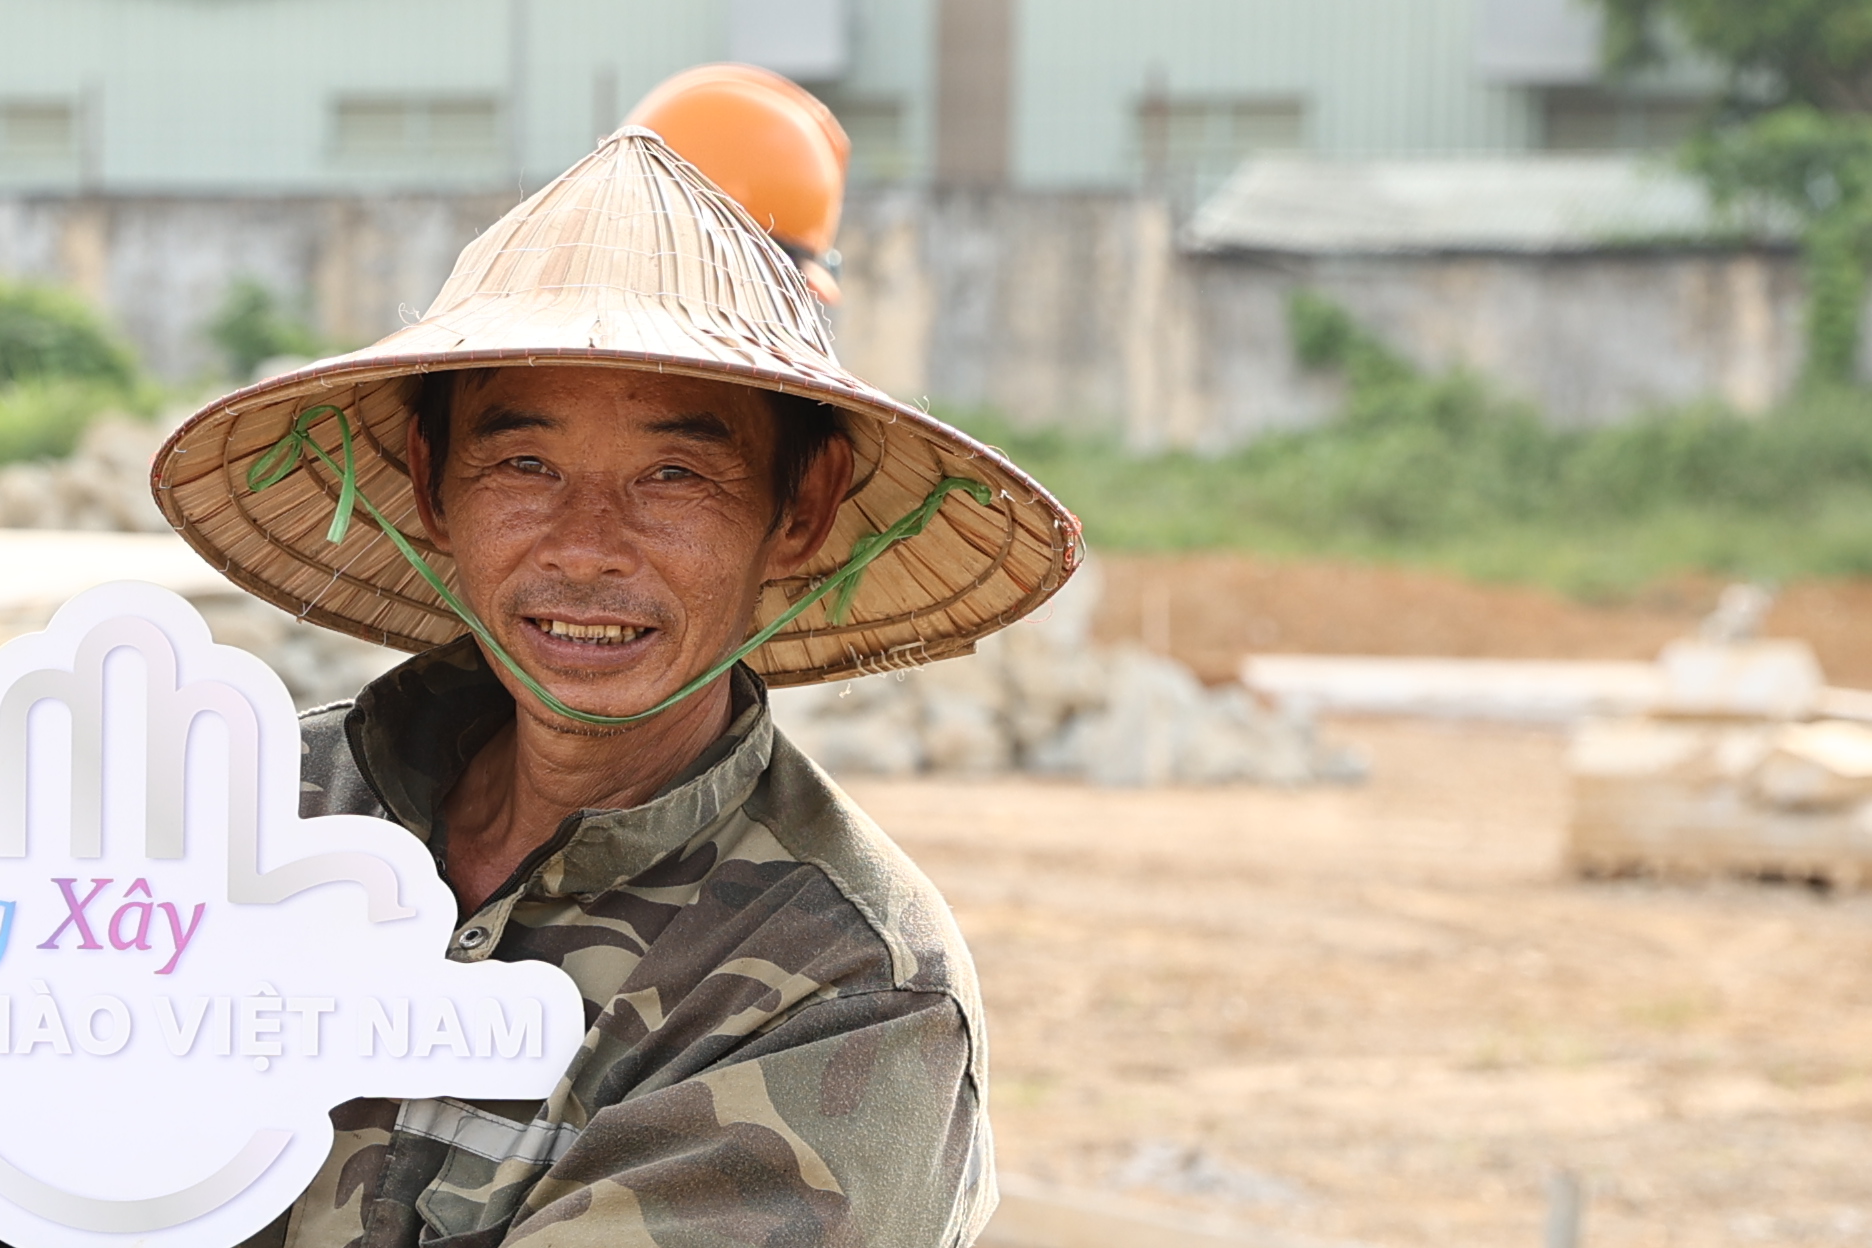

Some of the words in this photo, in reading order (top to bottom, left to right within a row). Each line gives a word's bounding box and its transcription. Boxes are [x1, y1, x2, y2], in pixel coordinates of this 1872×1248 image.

[35, 877, 207, 976] Xây
[153, 980, 336, 1073] VIỆT
[358, 997, 545, 1059] NAM
